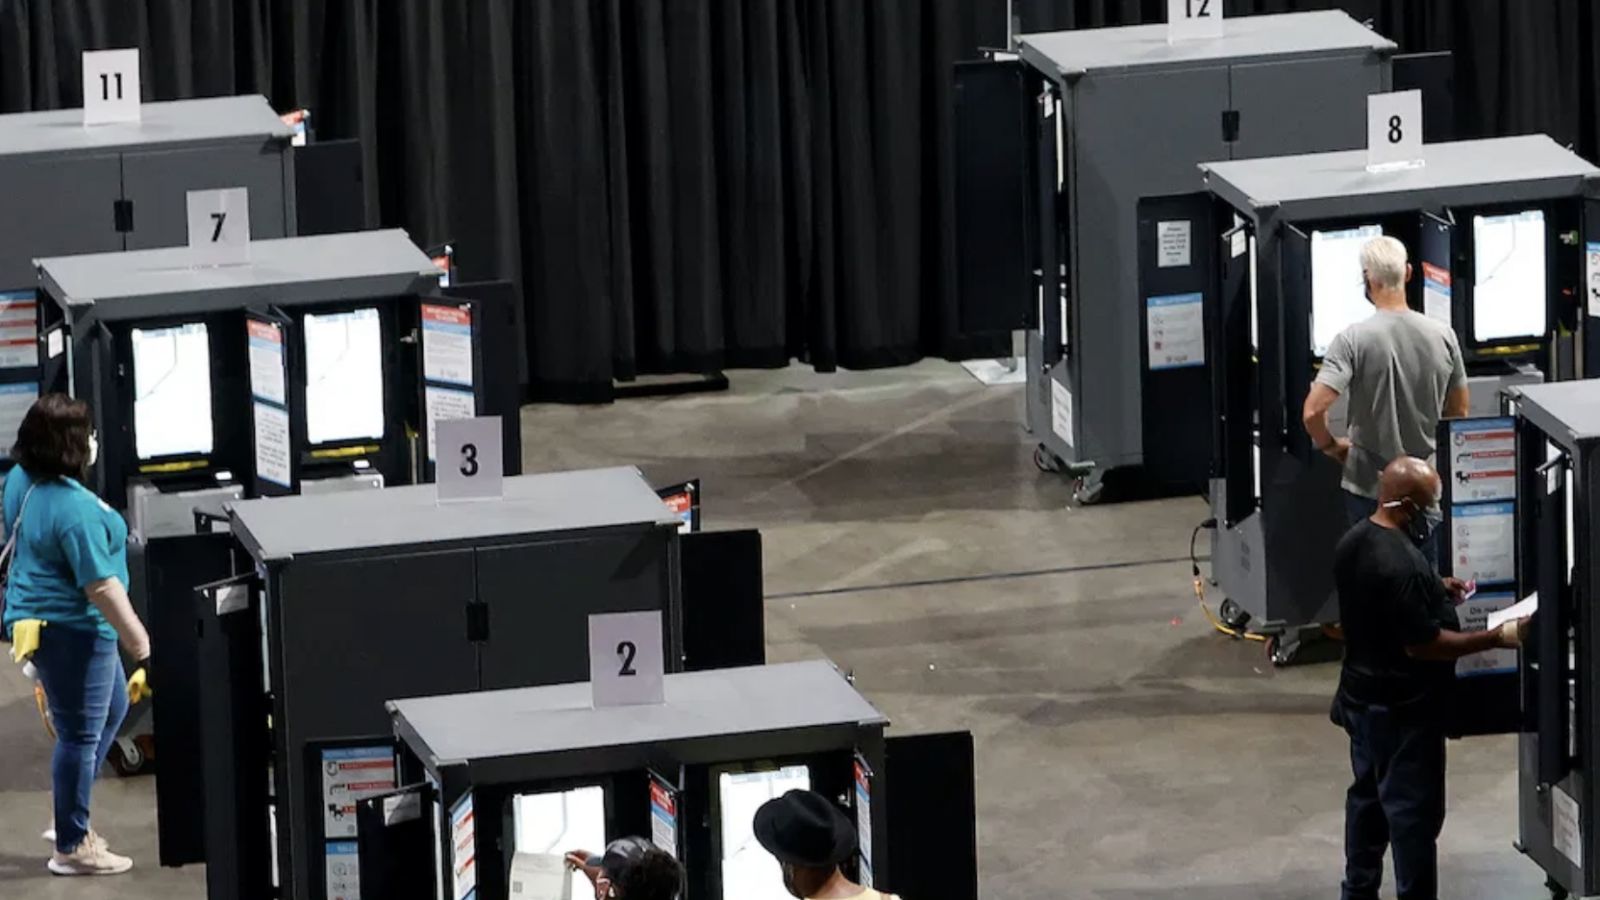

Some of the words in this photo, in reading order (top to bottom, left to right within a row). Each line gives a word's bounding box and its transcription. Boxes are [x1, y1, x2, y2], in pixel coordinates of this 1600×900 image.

[1186, 0, 1210, 18] 12
[99, 73, 122, 101] 11
[1388, 115, 1403, 144] 8
[210, 212, 226, 242] 7
[459, 442, 479, 477] 3
[616, 640, 637, 677] 2
